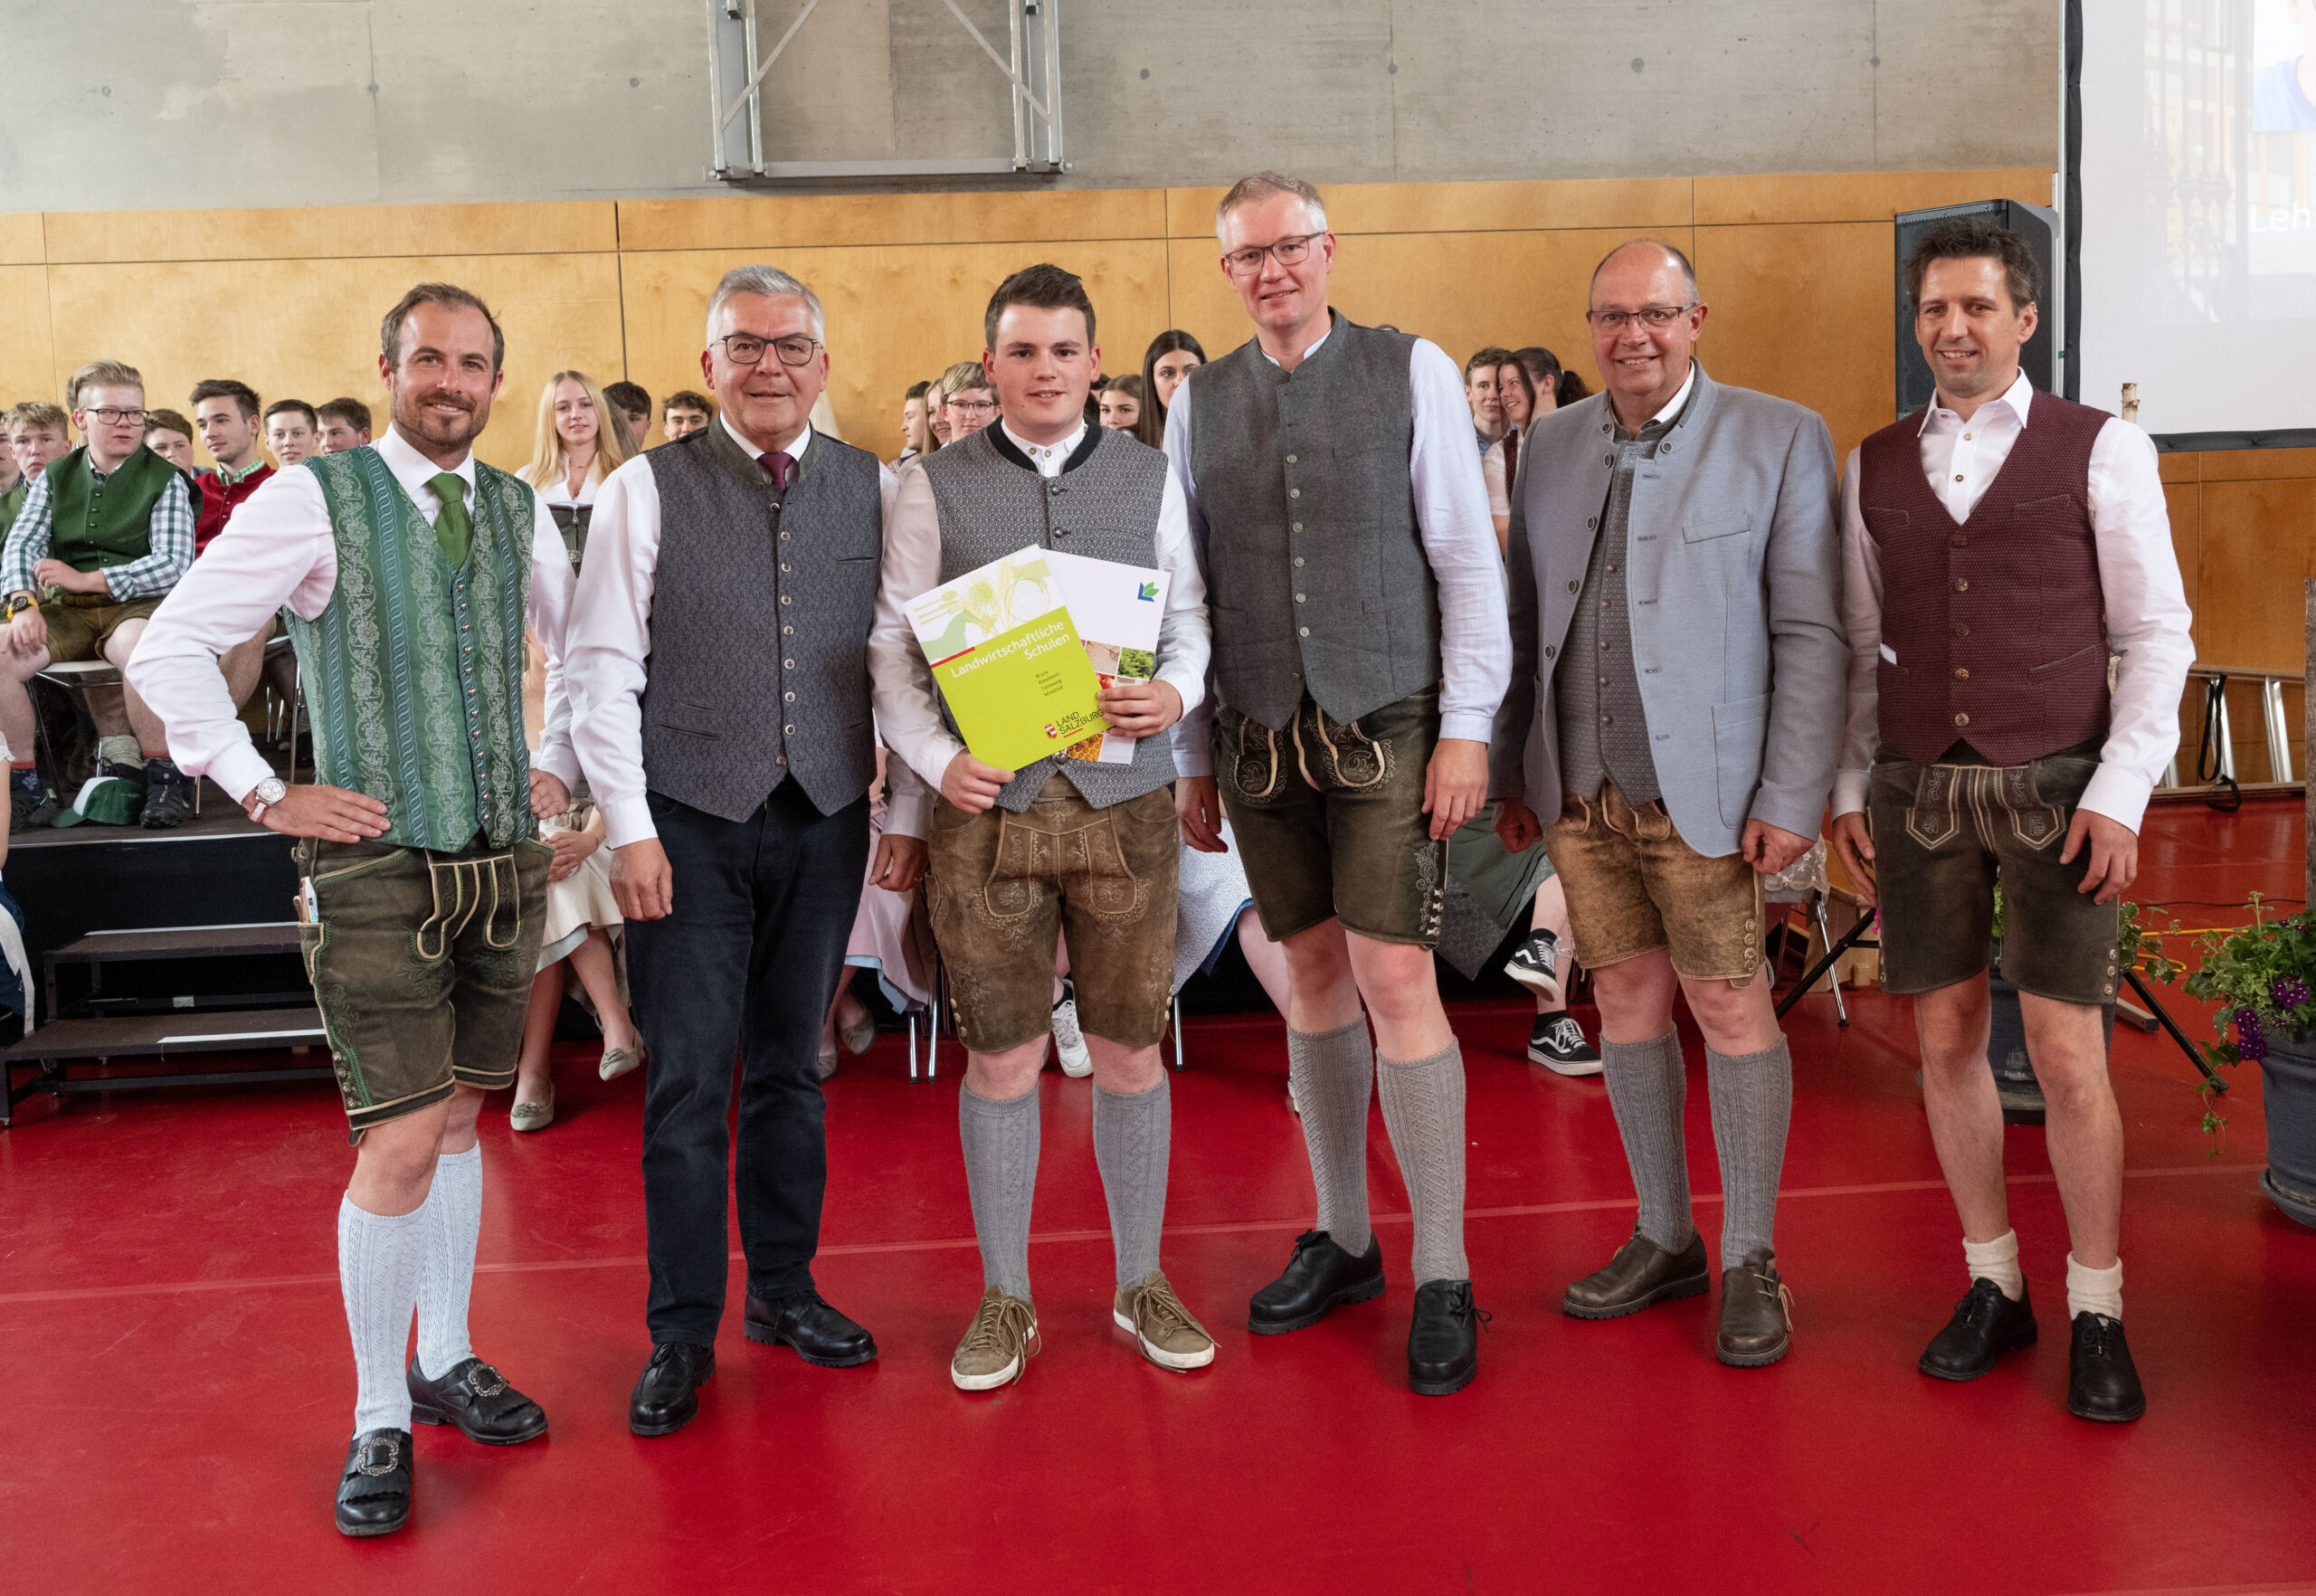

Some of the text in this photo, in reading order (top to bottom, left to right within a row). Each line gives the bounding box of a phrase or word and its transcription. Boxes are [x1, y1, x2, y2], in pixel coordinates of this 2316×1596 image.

[950, 622, 1065, 679] Landwirtschaftliche
[1024, 633, 1070, 660] Schulen
[1056, 711, 1080, 727] LAND
[1058, 709, 1105, 735] SALZBURG
